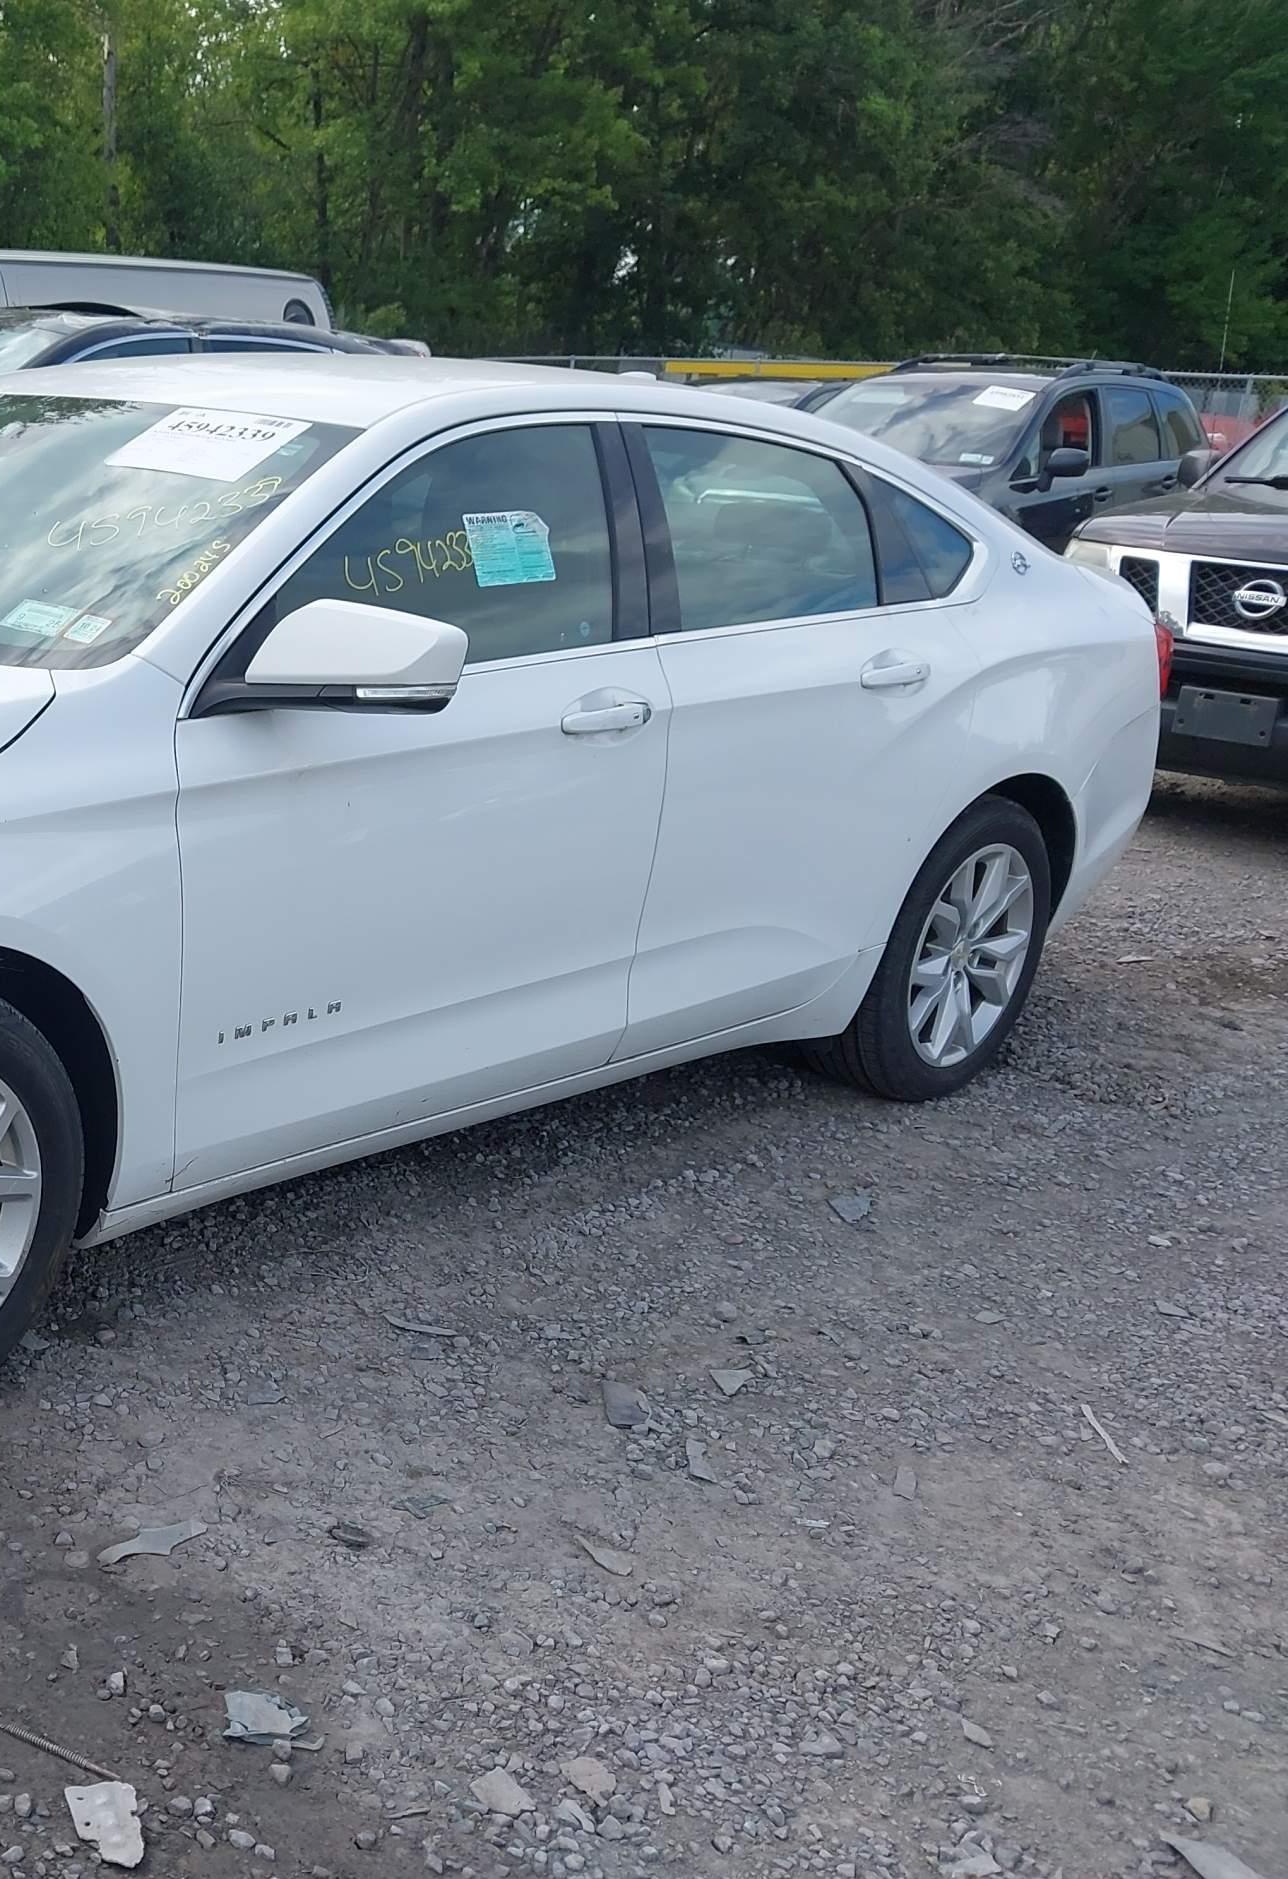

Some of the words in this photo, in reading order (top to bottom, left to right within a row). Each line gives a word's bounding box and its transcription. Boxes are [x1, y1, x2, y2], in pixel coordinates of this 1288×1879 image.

[168, 420, 276, 442] 45942339
[1236, 593, 1280, 603] NISSAN
[217, 999, 342, 1045] IMPALA
